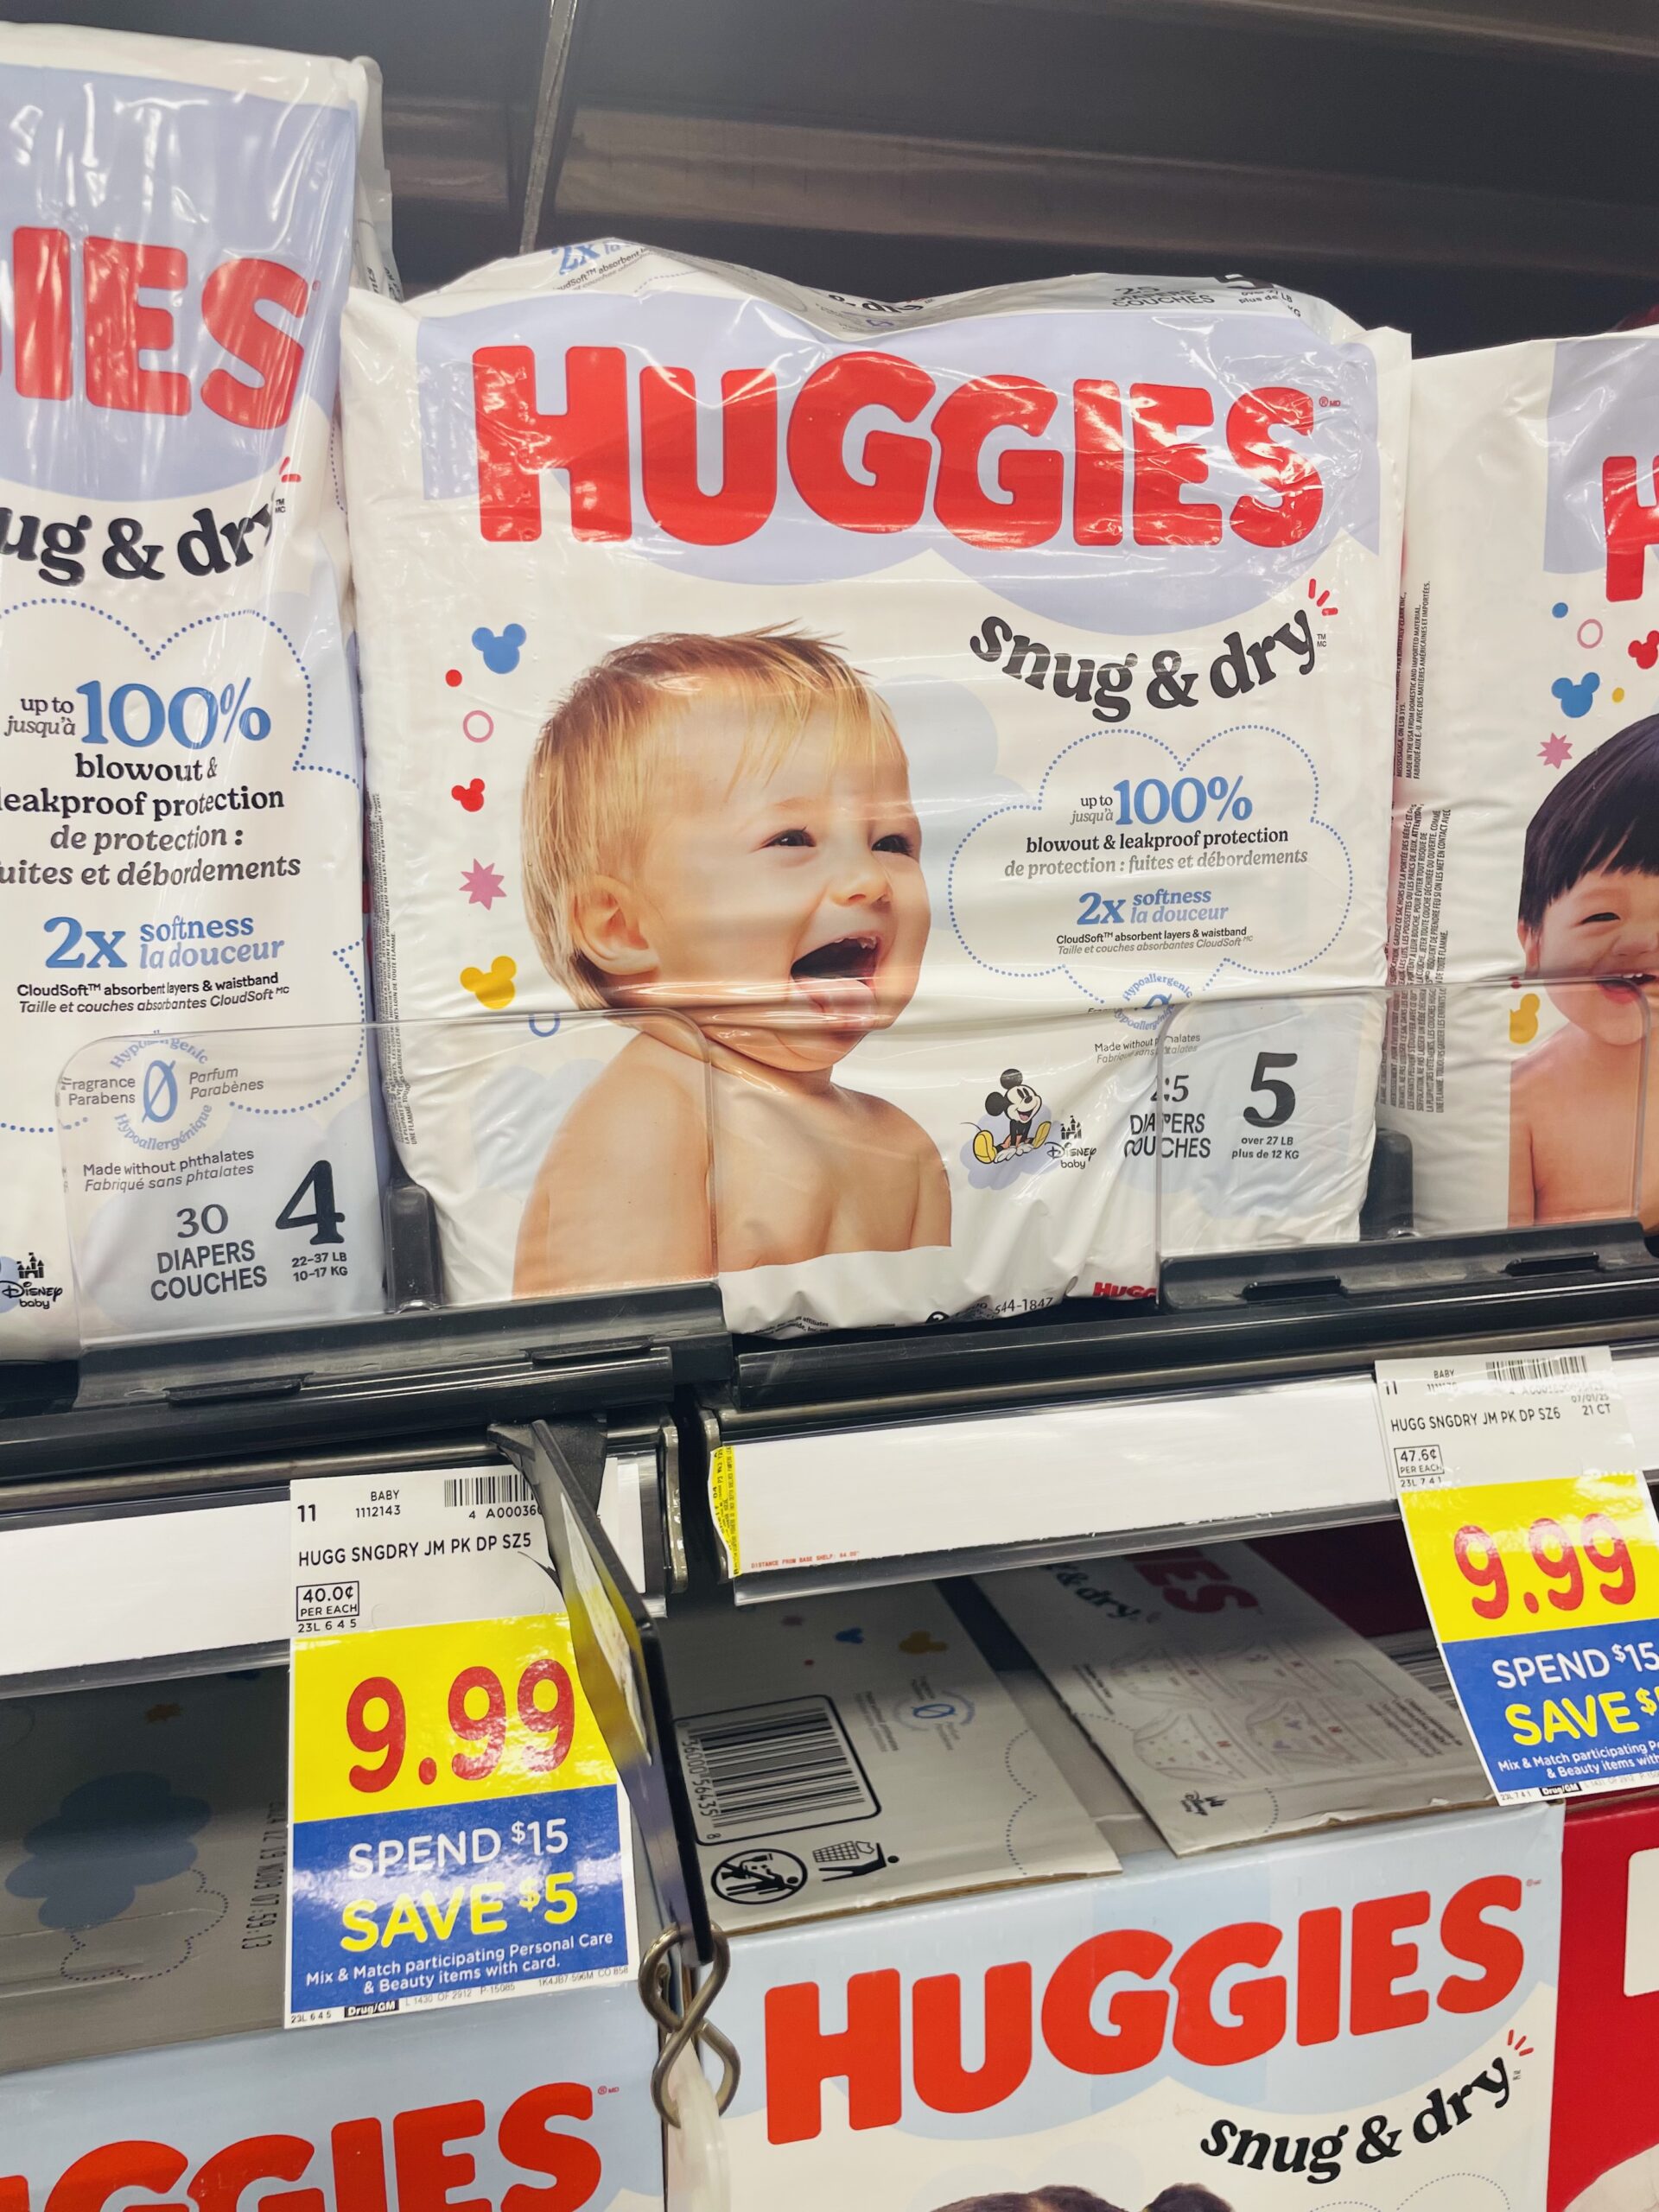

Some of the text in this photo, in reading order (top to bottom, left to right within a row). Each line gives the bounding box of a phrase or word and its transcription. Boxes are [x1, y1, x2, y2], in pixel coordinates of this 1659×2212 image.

[472, 346, 1325, 549] HUGGIES
[102, 518, 165, 580] &
[969, 609, 1316, 722] snug & dry
[1411, 637, 1420, 668] IMPORTED
[21, 697, 74, 713] up to
[76, 677, 271, 749] 100%
[3, 716, 76, 737] jusqu'à
[75, 753, 217, 781] blowout &
[0, 786, 284, 821] eakproof protection
[1080, 795, 1113, 807] up to
[1113, 775, 1253, 825] 100%
[1070, 808, 1114, 825] jusqu'à
[50, 824, 227, 855] de protection
[1026, 827, 1289, 853] blowout & leakproof protection
[0, 855, 302, 887] uites et débordements
[1004, 849, 1308, 879] de protection fuites et débordements
[1077, 888, 1211, 925] 2x softness
[1130, 906, 1229, 924] la douceur
[43, 914, 254, 969] 2x softness
[1096, 940, 1194, 953] couches absorbantes
[1115, 926, 1247, 942] absorbent layers waistband
[139, 940, 285, 969] la douceur
[104, 972, 278, 995] absorbent layers & waistband
[1123, 973, 1193, 1001] Hypoallergenic
[19, 998, 207, 1013] Taille et couches absorbantes
[1095, 1042, 1121, 1052] Made
[189, 1067, 238, 1084] Parfum
[190, 1079, 264, 1100] Parabènes
[68, 1092, 136, 1106] Parabens
[1243, 1052, 1298, 1128] 5
[1129, 1113, 1205, 1135] DIAPERS
[1231, 1149, 1300, 1160] plus de 12 KG
[1241, 1135, 1294, 1146] over 27 LB
[83, 1149, 255, 1177] Made without phthalates
[1060, 1159, 1086, 1170] baby
[85, 1164, 254, 1194] Fabriqué sans phtalates
[275, 1160, 346, 1246] 4
[176, 1204, 229, 1238] 30
[156, 1240, 256, 1274] DIAPERS
[291, 1252, 347, 1268] 22-37 LB
[150, 1265, 268, 1301] COUCHES
[292, 1265, 348, 1282] 10-17 KG
[19, 1298, 50, 1310] baby
[1434, 1370, 1454, 1379] BABY
[1391, 1404, 1611, 1432] HUGG SNGDRY JM PK DP SZ6 21 CT
[1400, 1448, 1437, 1462] 47.6¢
[371, 1490, 399, 1502] BABY
[297, 1503, 401, 1522] 11 1112143
[299, 1533, 531, 1567] HUGG SNGDRY JM PK DP SZ5
[1454, 1513, 1636, 1620] 9.99
[302, 1586, 354, 1603] 40.0¢
[301, 1604, 358, 1617] PER EACH
[298, 1623, 321, 1633] 23L
[1492, 1642, 1659, 1688] SPEND $15
[346, 1659, 575, 1793] 9.99
[1505, 1691, 1640, 1746] SAVE
[1497, 1744, 1647, 1772] Mix & Match participating
[1547, 1758, 1636, 1779] & Beauty items
[682, 1738, 719, 1817] 36000 56435
[348, 1818, 569, 1879] SPEND $15
[340, 1872, 578, 1952] SAVE $5
[306, 1933, 613, 1986] Mix & Match participating Personal Care
[363, 1955, 560, 1994] & Beauty items with card.
[347, 2000, 396, 2018] Drug/GM
[765, 1875, 1524, 2145] HUGGIES
[1201, 2056, 1510, 2183] snug & dry
